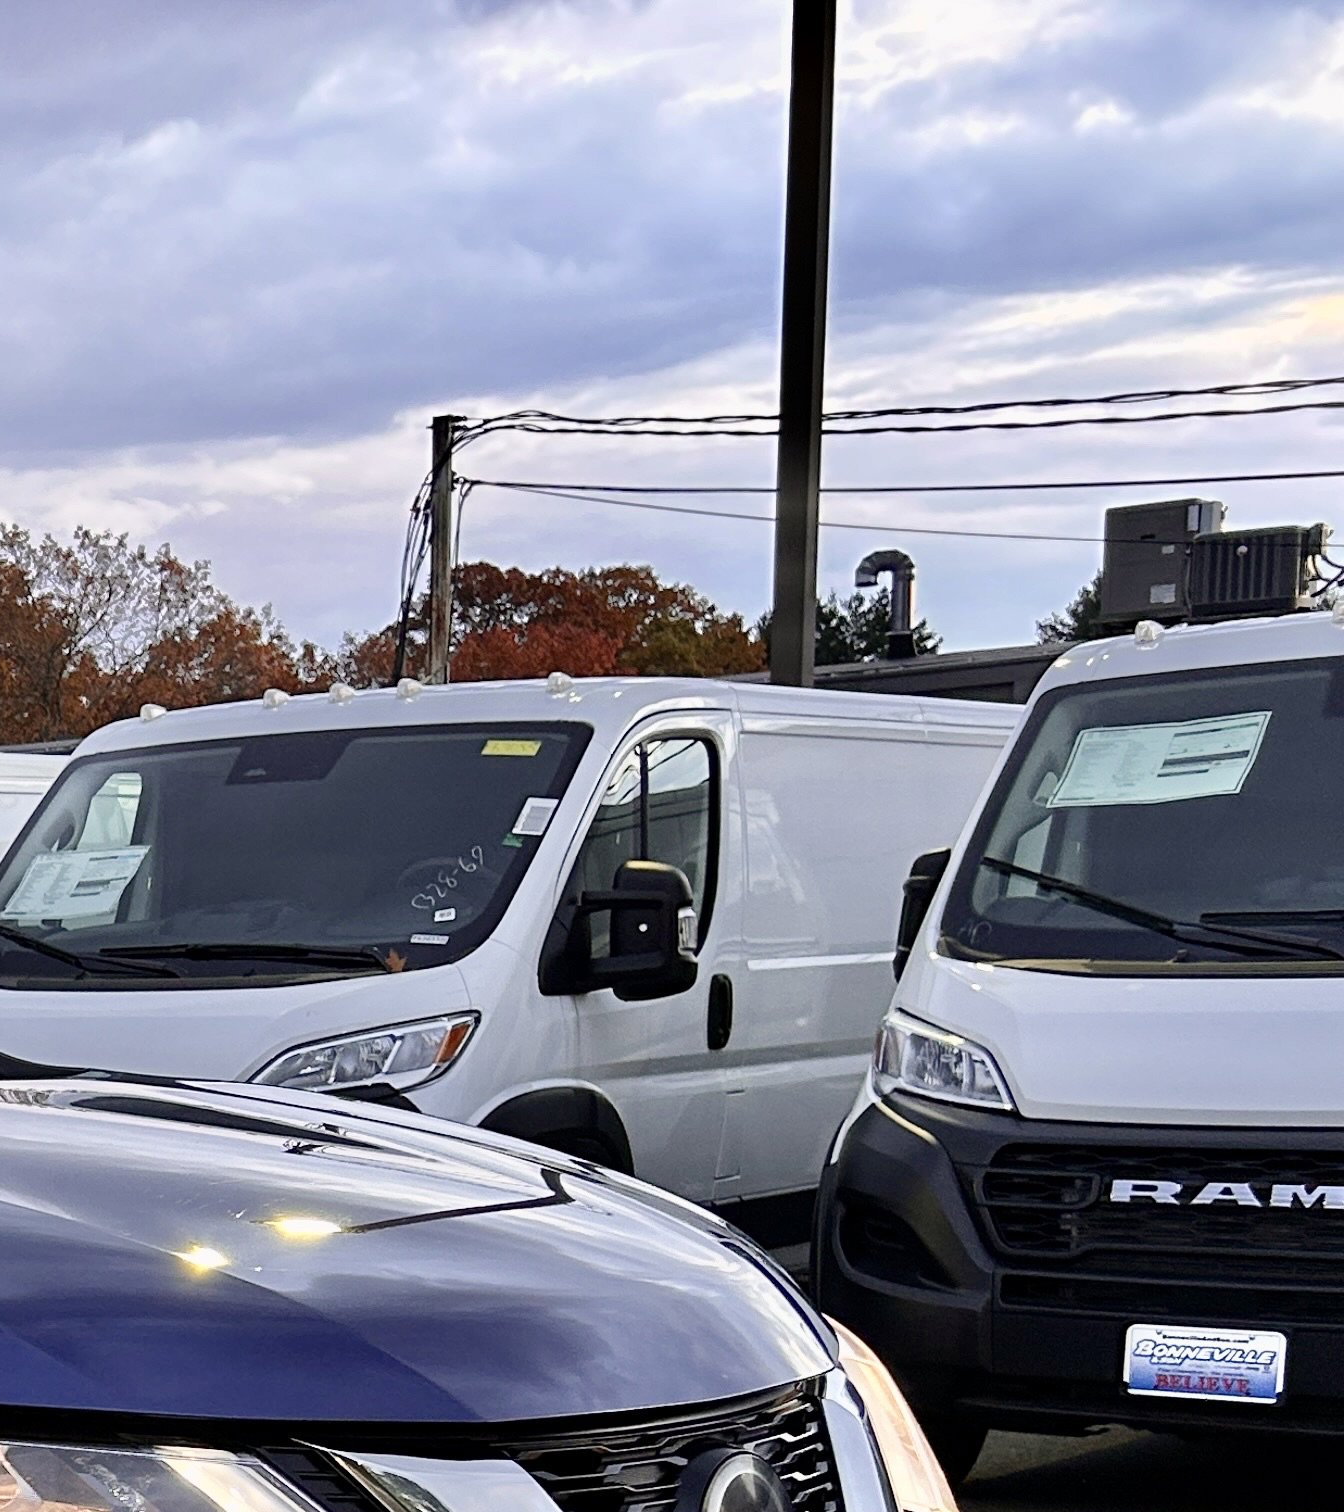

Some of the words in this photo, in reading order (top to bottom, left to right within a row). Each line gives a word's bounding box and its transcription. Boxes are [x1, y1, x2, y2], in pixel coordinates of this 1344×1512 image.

[1110, 1179, 1344, 1210] RAM
[1132, 1338, 1278, 1366] BONNEVILLE
[1154, 1373, 1250, 1394] BELIEVE
